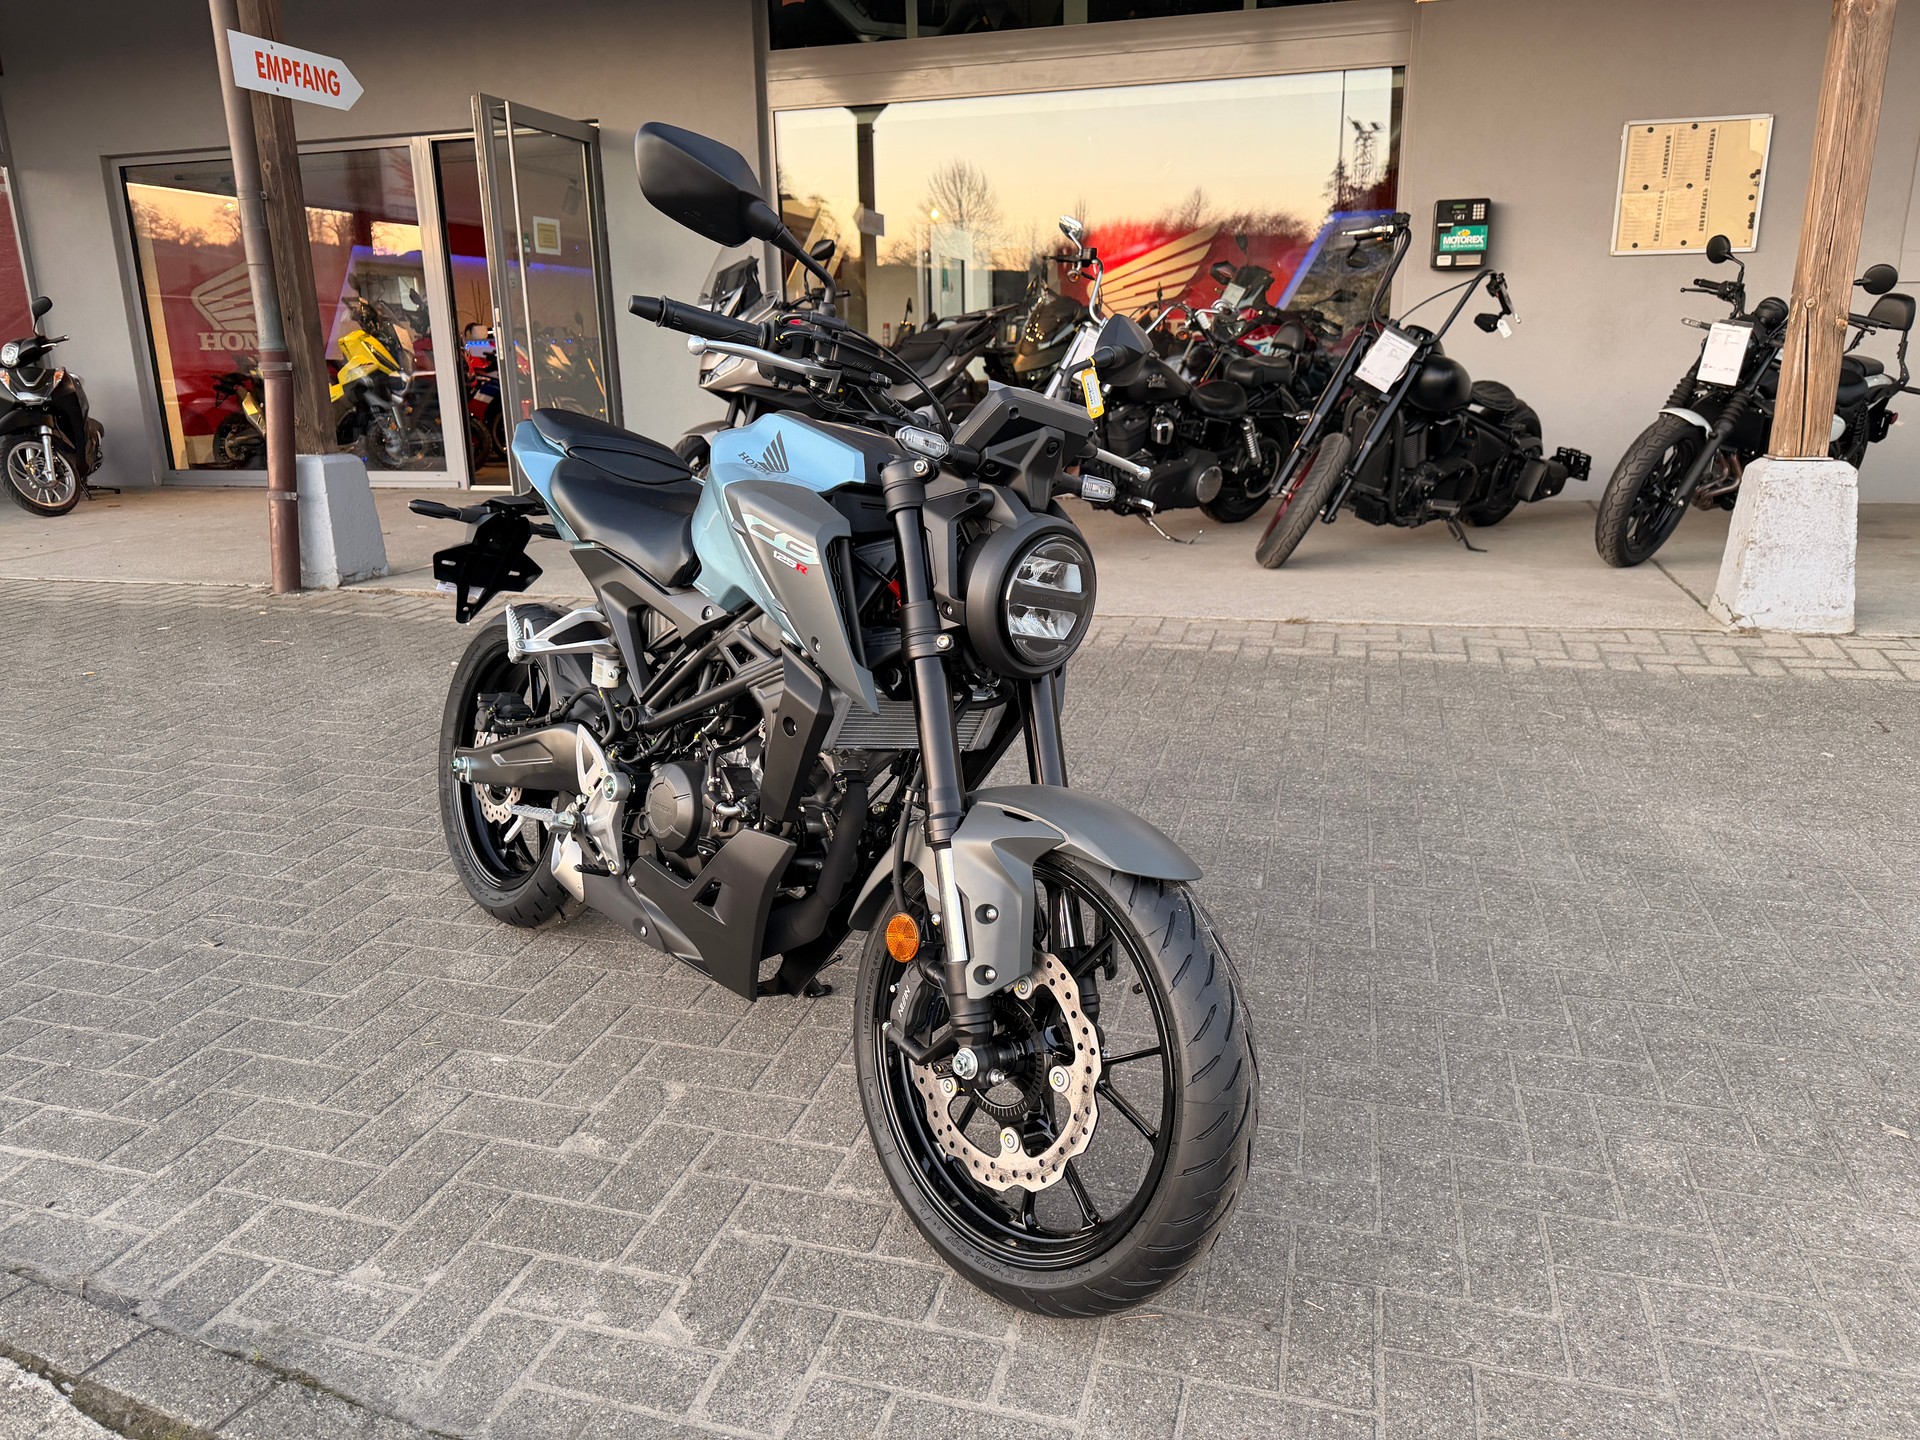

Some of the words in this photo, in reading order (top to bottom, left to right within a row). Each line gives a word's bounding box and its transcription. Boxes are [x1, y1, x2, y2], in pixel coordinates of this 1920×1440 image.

[254, 50, 341, 97] EMPFANG
[1443, 236, 1484, 246] MOTOREX
[197, 332, 258, 351] HON
[741, 513, 821, 565] CB
[773, 550, 809, 576] 125R
